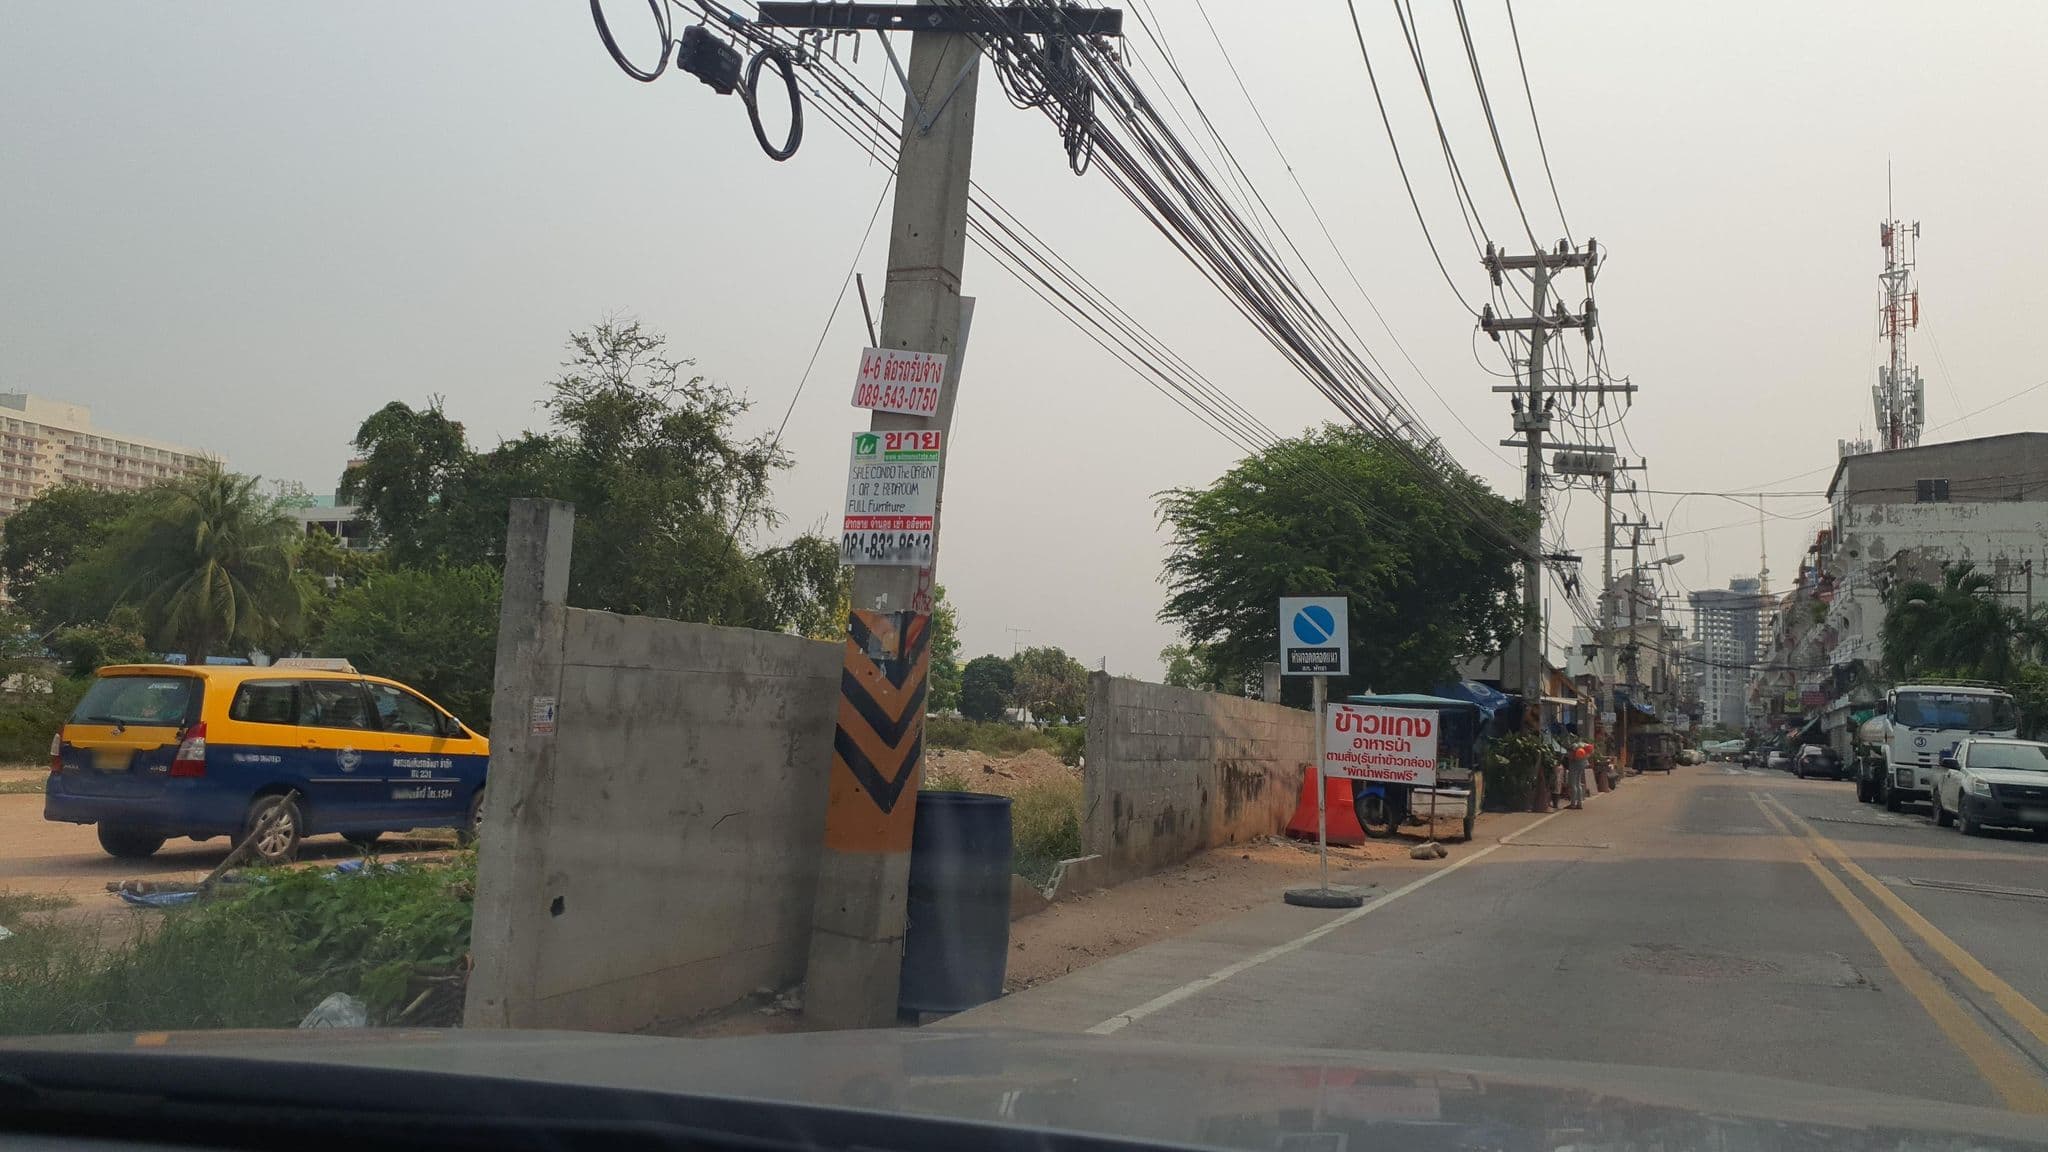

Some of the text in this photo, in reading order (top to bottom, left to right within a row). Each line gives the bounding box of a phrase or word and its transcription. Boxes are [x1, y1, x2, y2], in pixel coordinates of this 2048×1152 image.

[863, 352, 942, 383] 4-6 ล้อรถรับจ้าง
[857, 383, 938, 412] 089-543-0750
[885, 431, 940, 450] ขาย
[870, 465, 896, 480] CONDO
[910, 465, 937, 480] ORIENT
[858, 483, 870, 496] OR
[873, 483, 880, 496] 2
[848, 499, 906, 513] FULL Furniture
[1335, 706, 1431, 738] ข้าวแกง
[1353, 737, 1411, 752] อาหารป่า
